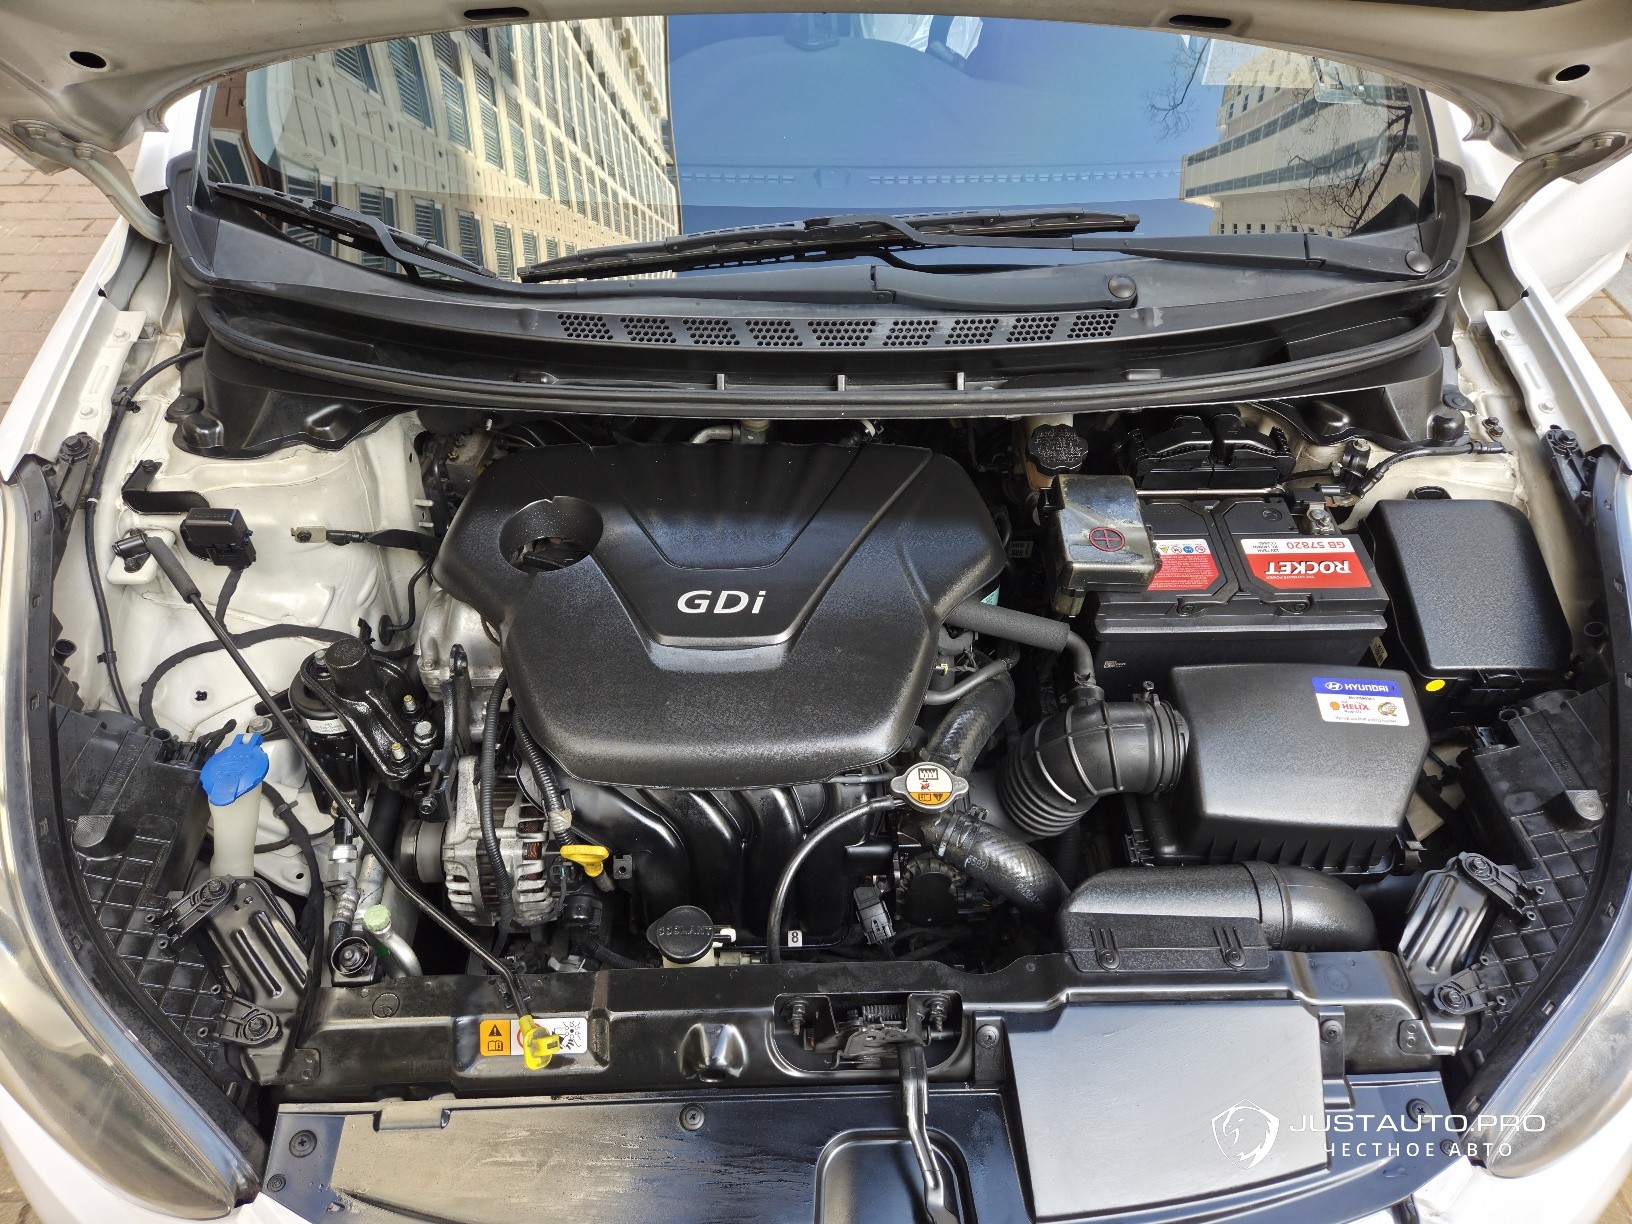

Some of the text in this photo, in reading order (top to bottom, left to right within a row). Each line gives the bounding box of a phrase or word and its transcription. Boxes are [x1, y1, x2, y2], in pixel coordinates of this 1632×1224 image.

[1286, 541, 1325, 549] 57820
[1329, 541, 1345, 549] GB
[1265, 560, 1353, 574] ROCKET
[677, 590, 766, 614] GDi
[1344, 683, 1389, 692] HYUNDAI
[1342, 703, 1370, 711] HELIX
[791, 931, 799, 943] 8
